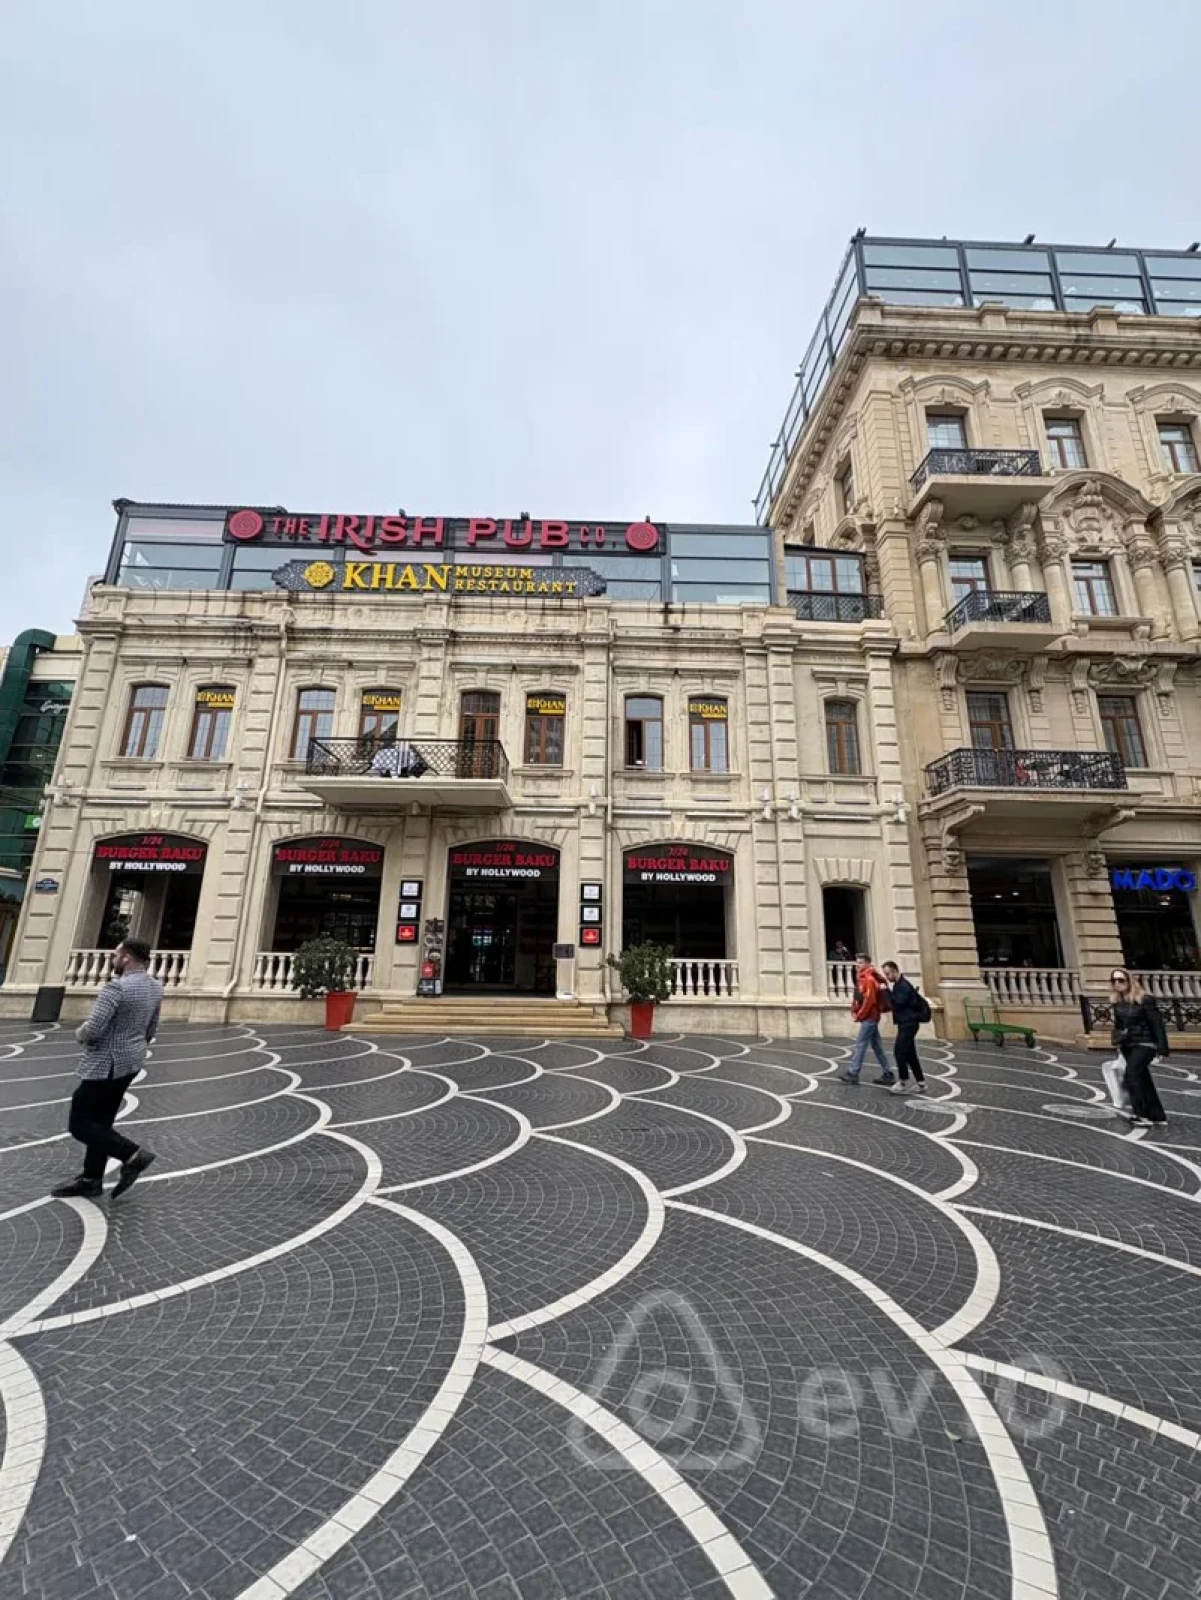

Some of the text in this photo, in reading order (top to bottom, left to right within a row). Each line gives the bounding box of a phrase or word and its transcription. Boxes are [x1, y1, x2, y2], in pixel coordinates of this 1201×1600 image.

[272, 516, 309, 536] THE
[318, 514, 445, 549] IRISH
[467, 518, 570, 546] PUB
[343, 563, 452, 591] KHAN
[455, 566, 533, 579] MUSEUM
[455, 580, 577, 593] RESTAURANT
[96, 846, 157, 859] BURGER
[276, 848, 336, 861] BURGER
[109, 861, 187, 872] BY HOLLYWOOD
[453, 854, 511, 866] BURGER
[627, 857, 687, 870] BURGER
[289, 864, 366, 873] BY HOLLYWOOD
[466, 868, 541, 878] BY HOLLYWOOD
[641, 872, 717, 882] BY HOLLYWOOD
[1113, 868, 1197, 891] MADO
